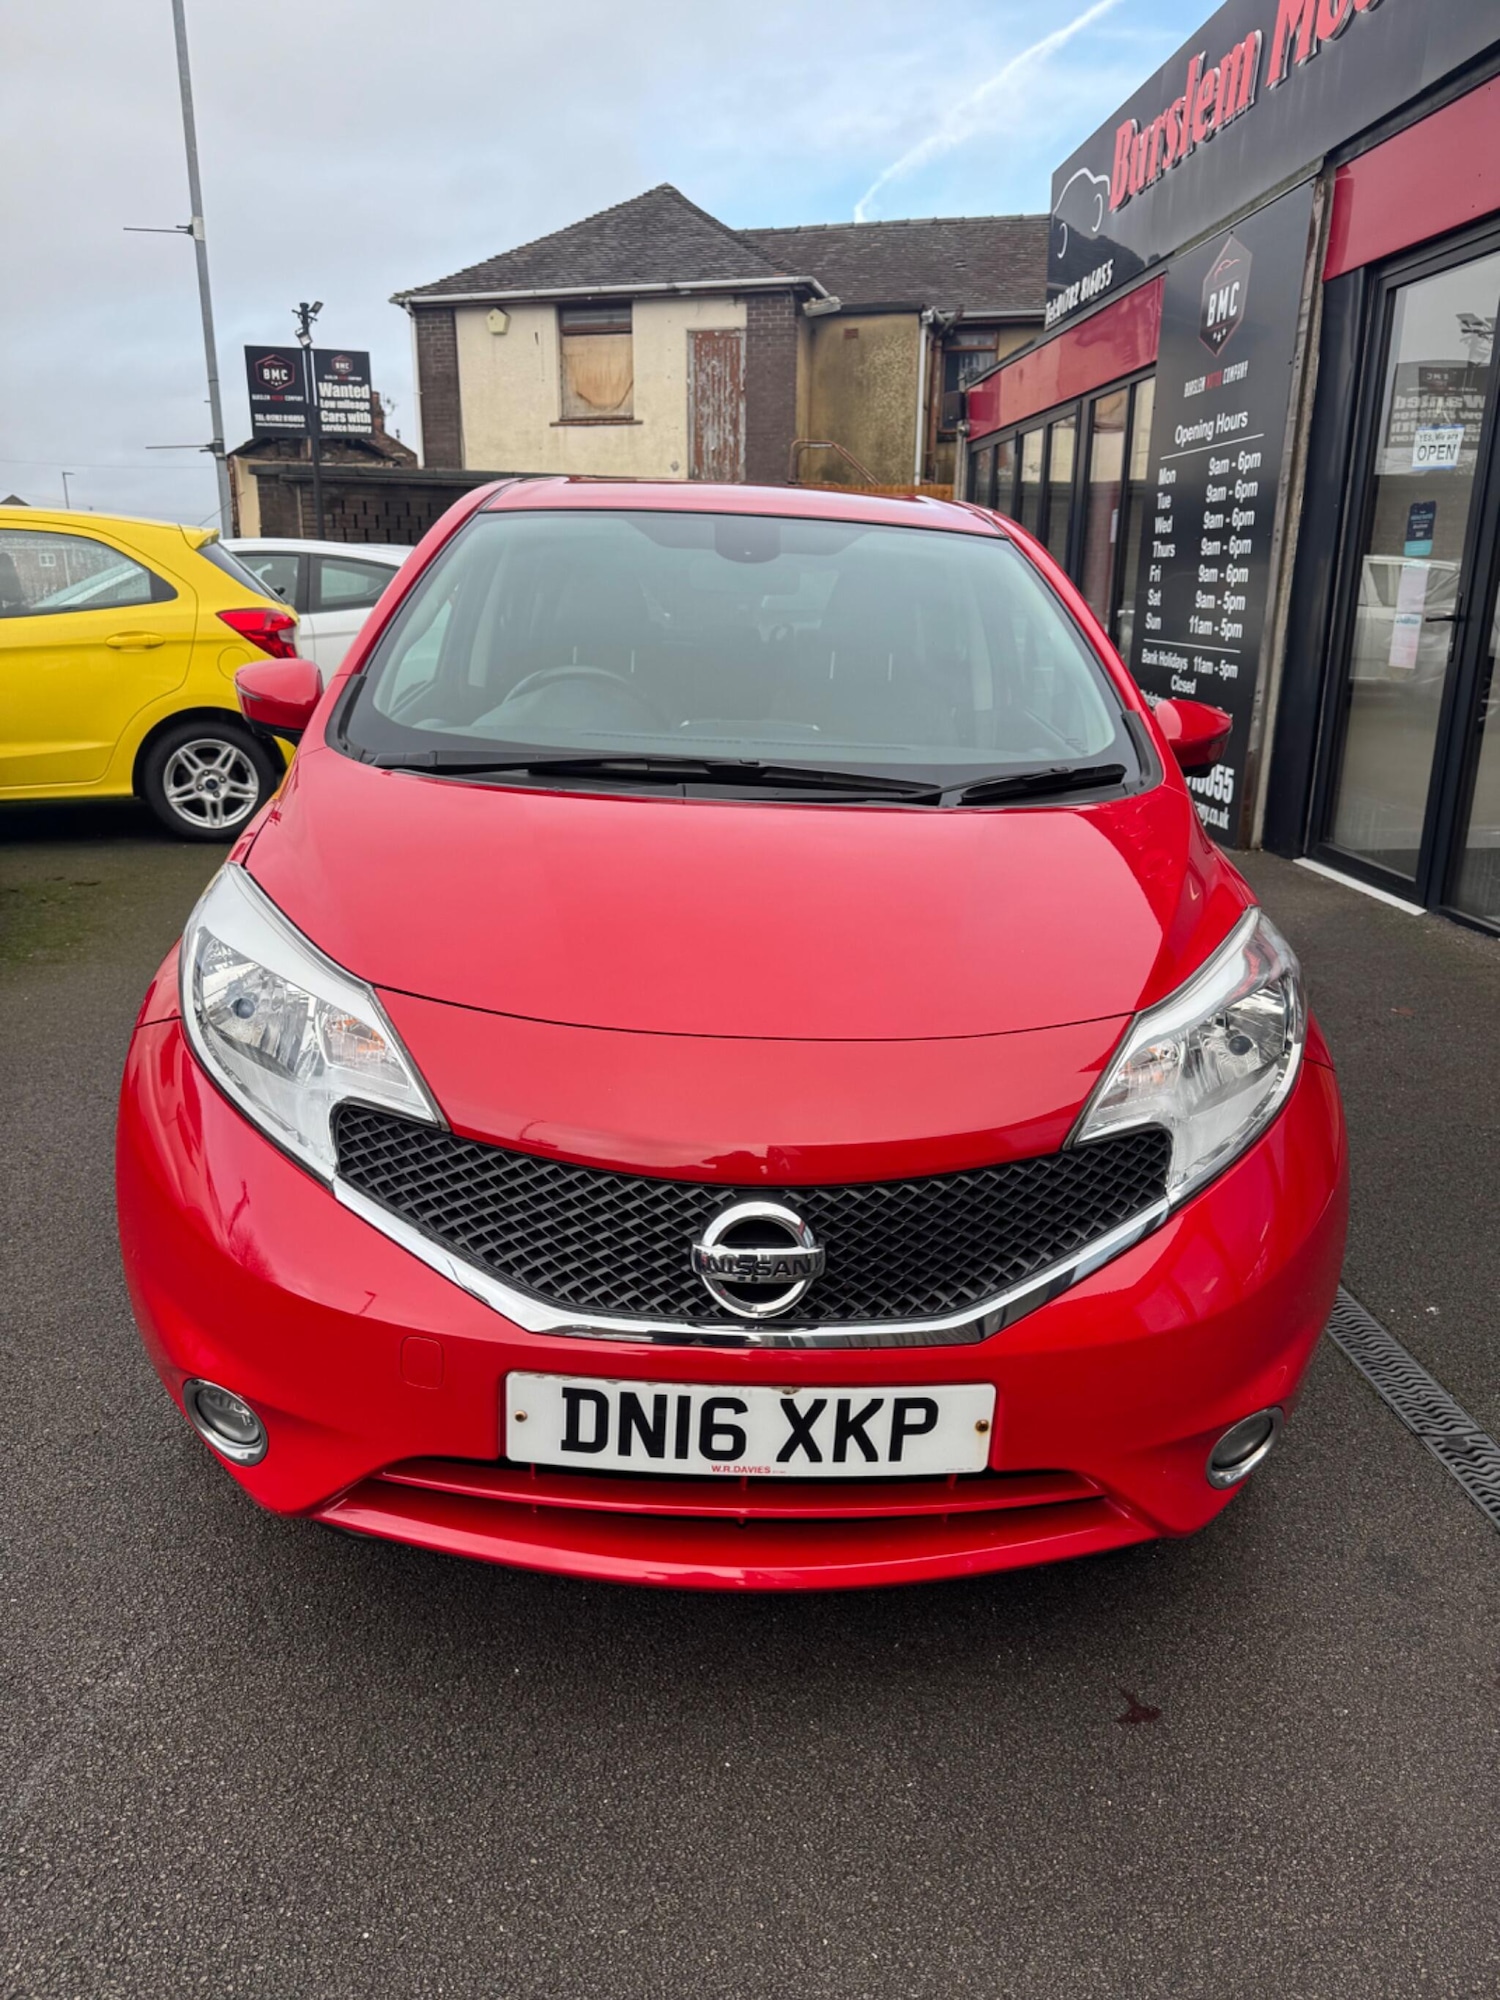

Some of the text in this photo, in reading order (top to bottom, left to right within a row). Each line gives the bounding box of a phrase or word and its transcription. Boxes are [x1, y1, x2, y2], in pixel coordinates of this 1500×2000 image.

[1109, 28, 1262, 214] Burslem
[1206, 281, 1240, 327] BMC
[263, 368, 288, 380] BMC
[1222, 360, 1249, 385] COMPANY
[318, 382, 371, 399] Wanted
[320, 398, 370, 411] Low mileage
[320, 410, 371, 424] Cars with
[321, 424, 372, 434] service history
[1175, 410, 1249, 447] Opening Hours
[1417, 444, 1457, 461] OPEN
[1158, 467, 1176, 485] Mon
[1208, 457, 1230, 476] 9am
[1238, 450, 1261, 475] 6pm
[1157, 492, 1171, 509] Tue
[1206, 484, 1227, 503] 9am
[1235, 479, 1258, 503] 6pm
[1155, 515, 1173, 534] Wed
[1203, 511, 1224, 530] 9am
[1232, 507, 1255, 532] 6pm
[1152, 540, 1176, 558] Thurs
[1200, 537, 1221, 556] 9am
[1229, 535, 1252, 559] 6pm
[1149, 565, 1161, 582] Fri
[1198, 564, 1218, 583] 9am
[1226, 563, 1249, 588] 6pm
[1147, 588, 1161, 606] Sat
[1195, 590, 1216, 609] 9am
[1222, 591, 1246, 615] 5pm
[1145, 612, 1162, 630] Sun
[1189, 615, 1213, 635] 11am
[1220, 618, 1243, 642] 5pm
[1141, 648, 1158, 664] Bank
[1159, 650, 1188, 674] Holidays
[1193, 656, 1214, 674] 11am
[1219, 659, 1238, 681] 5pm
[1171, 674, 1197, 695] Closed
[705, 1254, 811, 1278] NISSAN
[560, 1386, 939, 1463] DN16 XKP
